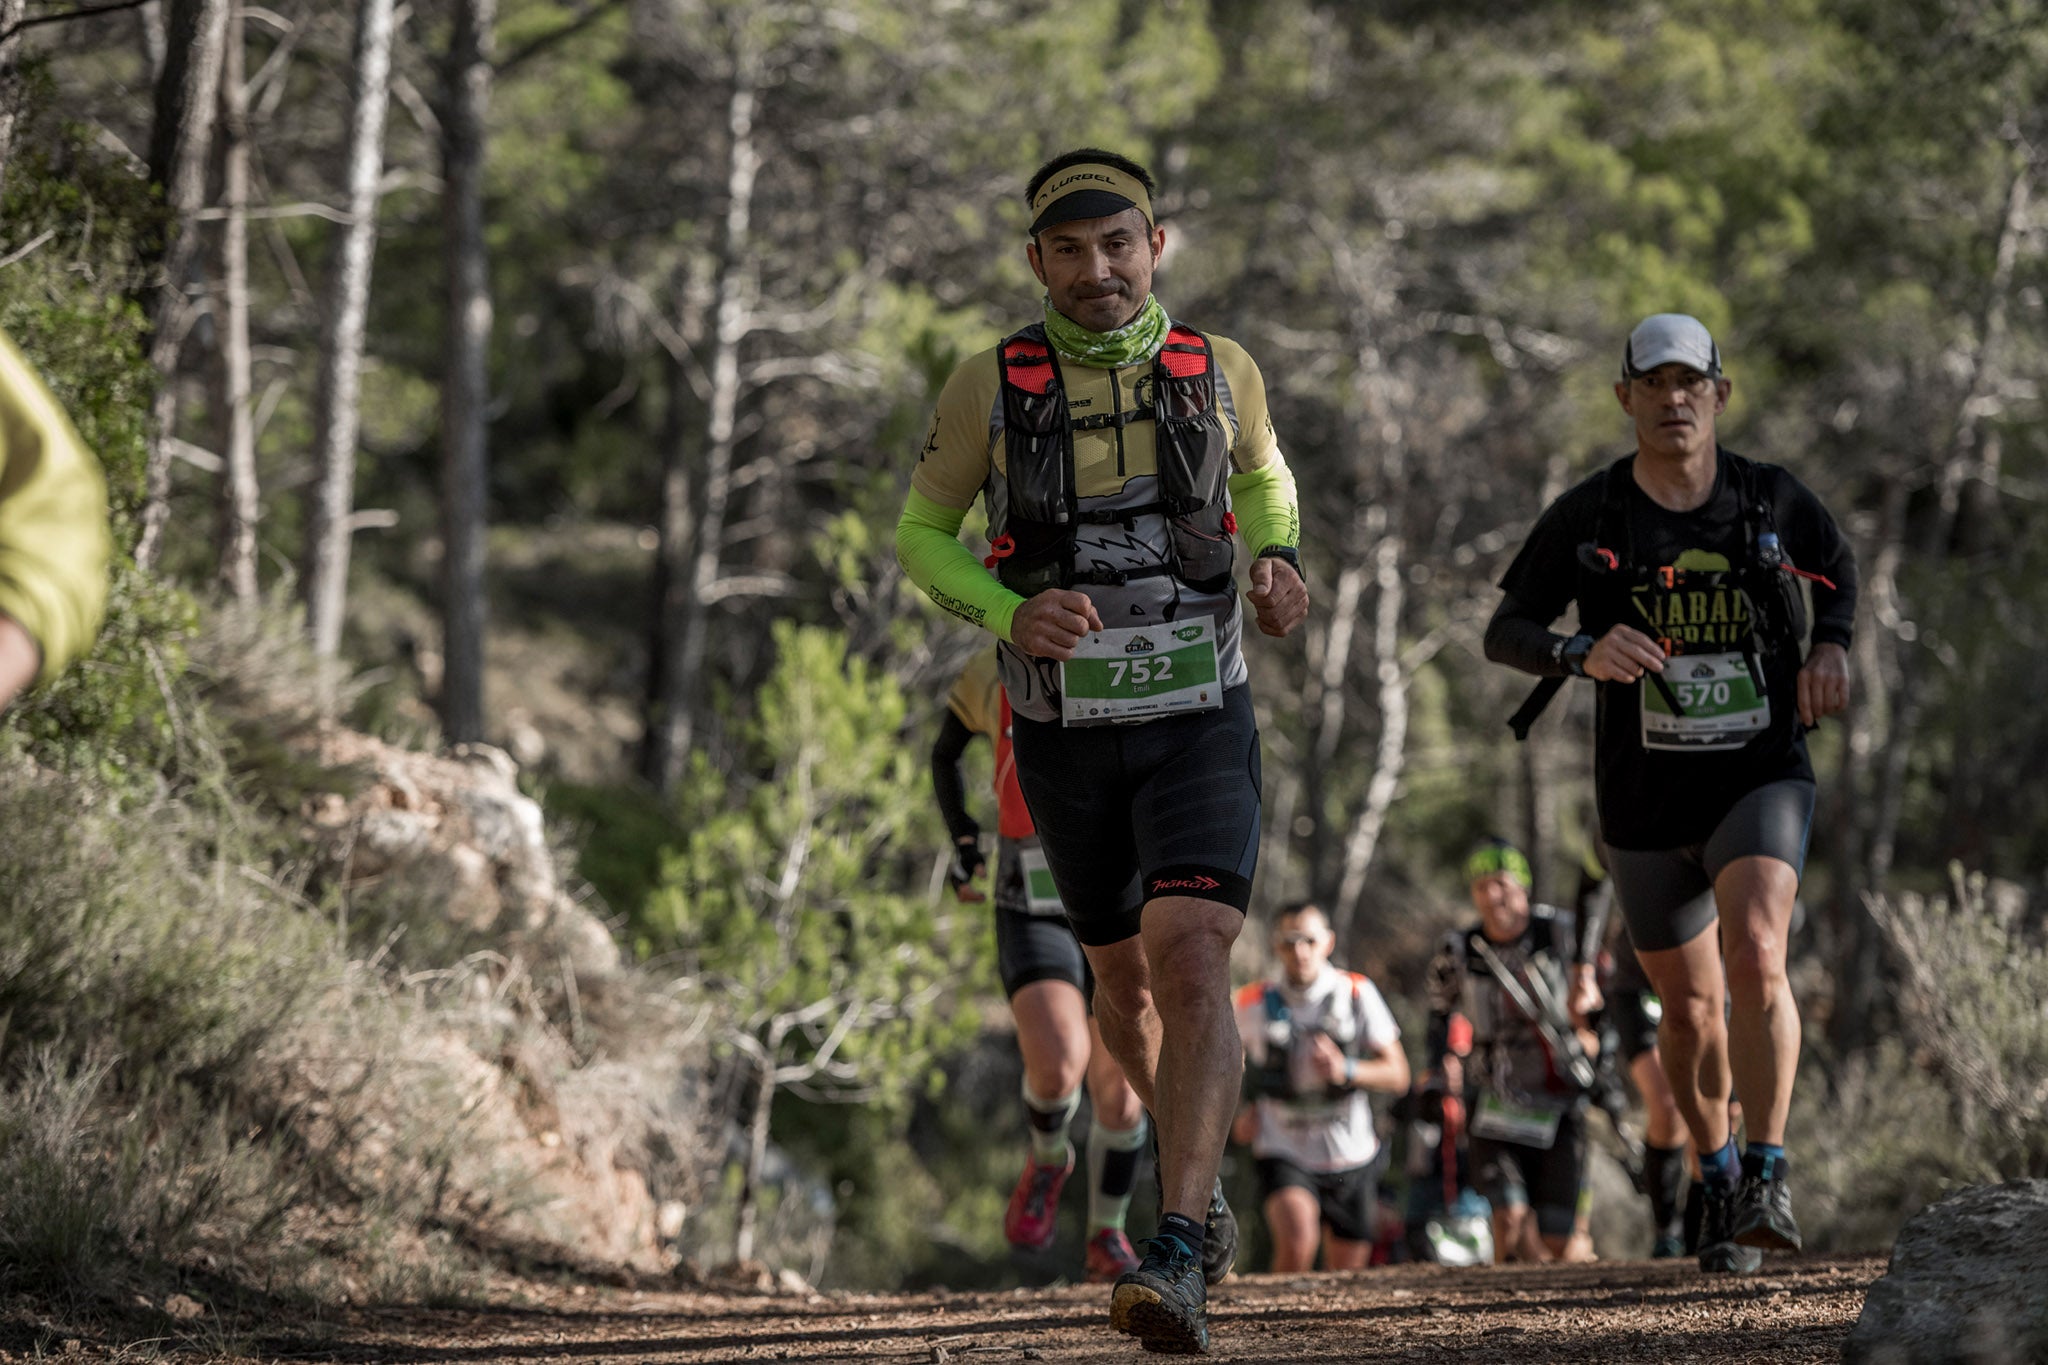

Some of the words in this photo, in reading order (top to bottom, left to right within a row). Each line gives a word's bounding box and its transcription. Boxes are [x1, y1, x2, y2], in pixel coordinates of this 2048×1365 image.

[1051, 173, 1116, 193] LURBEL
[929, 584, 987, 621] BRONCHALES
[1181, 628, 1198, 639] 30K
[1126, 641, 1154, 652] TRAIL
[1108, 655, 1174, 687] 752
[1132, 684, 1151, 694] Emili
[1676, 682, 1731, 707] 570
